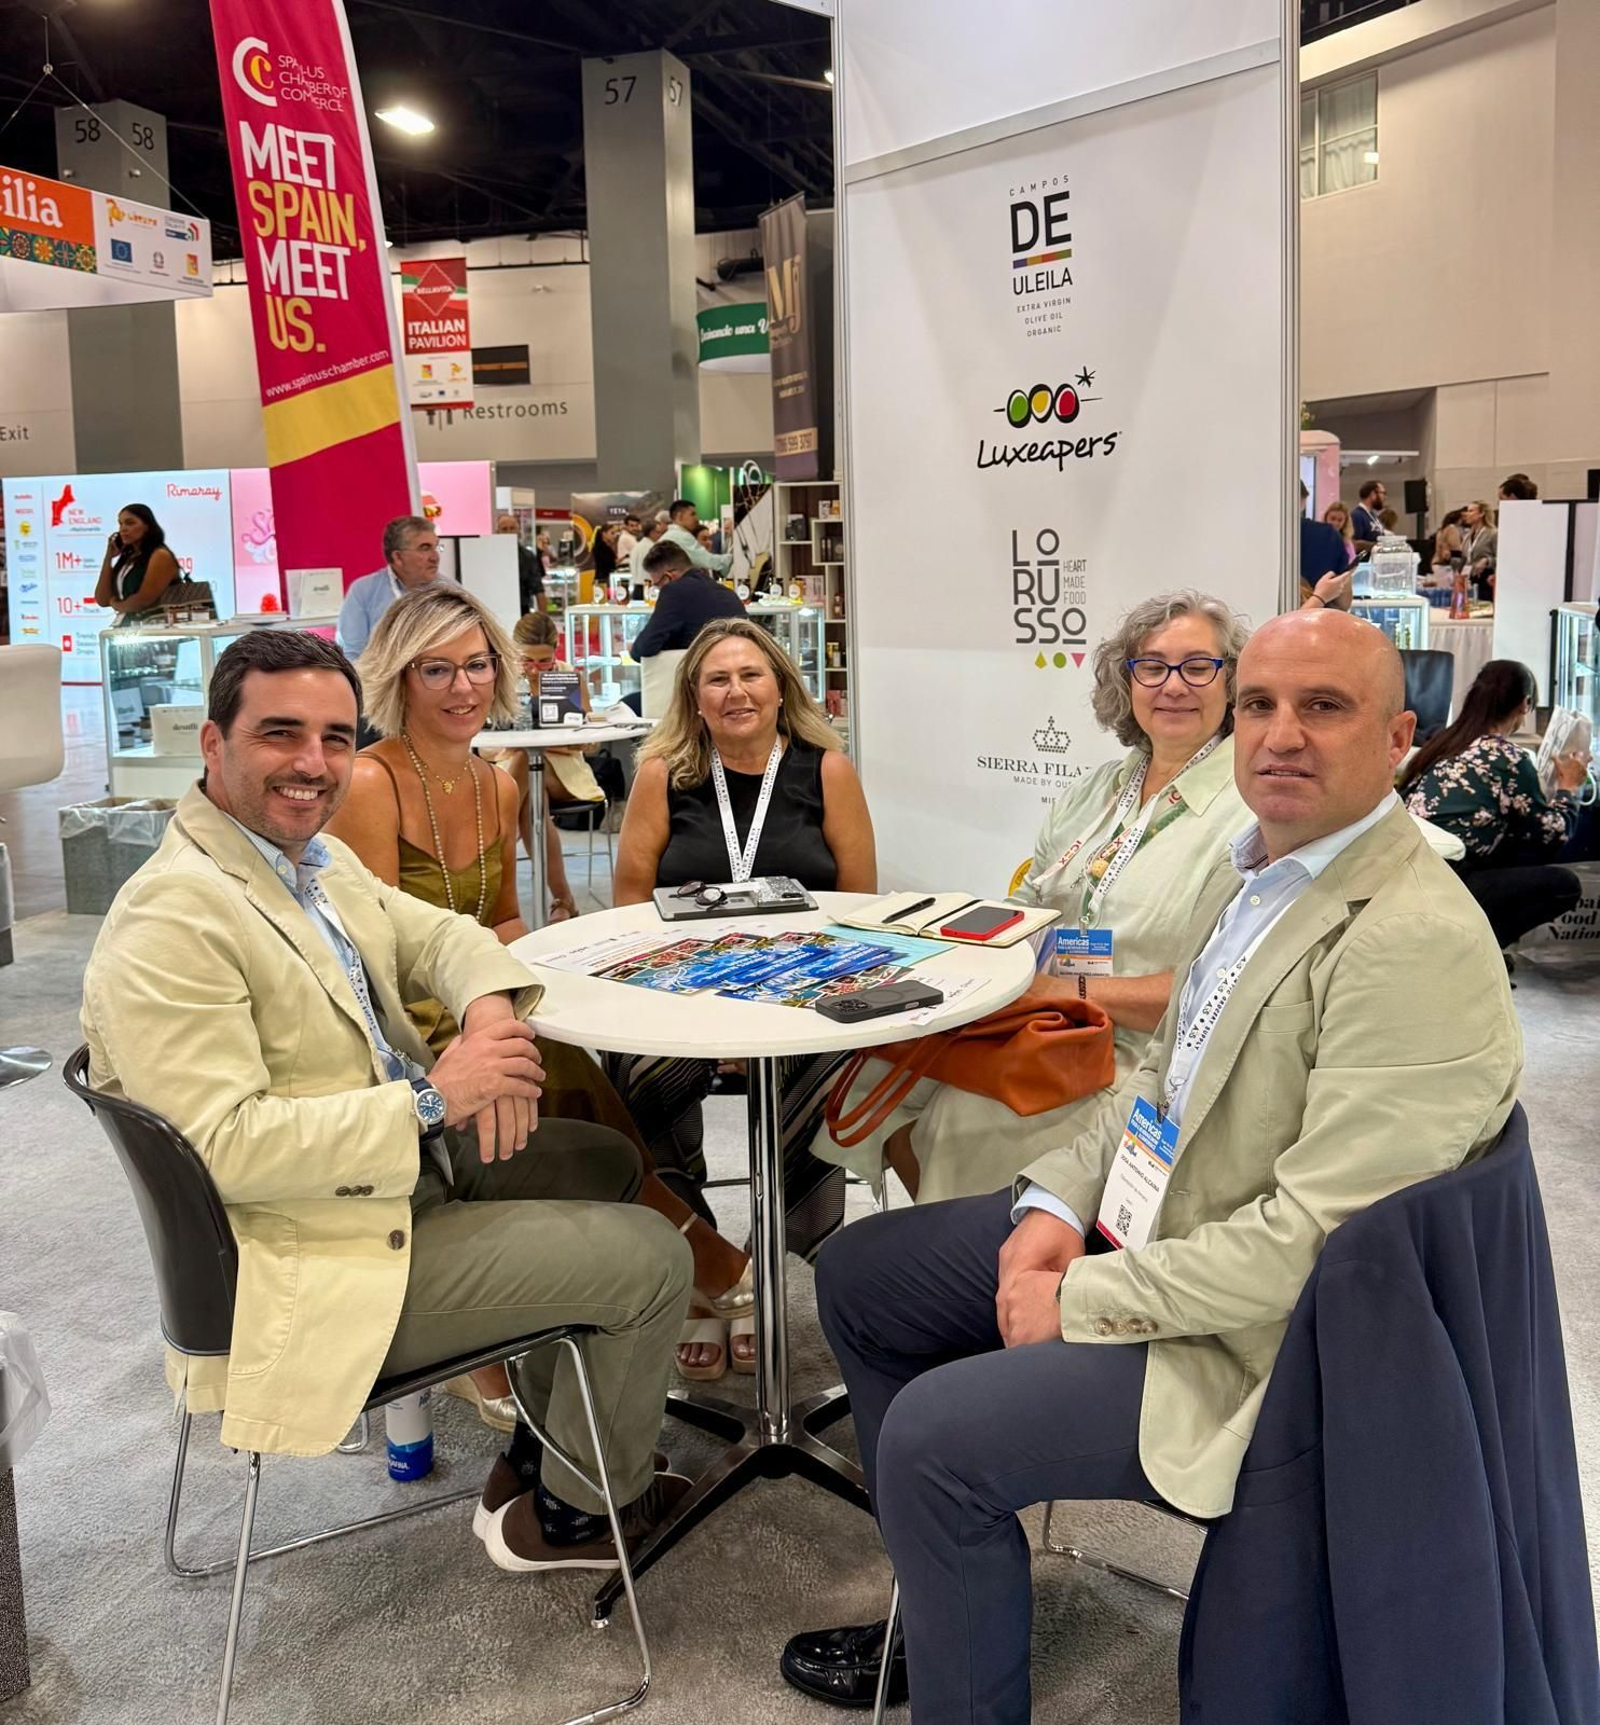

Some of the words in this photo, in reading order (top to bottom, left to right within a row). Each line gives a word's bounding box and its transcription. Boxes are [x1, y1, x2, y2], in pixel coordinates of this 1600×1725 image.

[604, 75, 637, 105] 57
[669, 75, 684, 107] 57
[75, 119, 101, 143] 58
[131, 122, 155, 151] 58
[238, 119, 337, 190] MEET
[1009, 174, 1069, 197] CAMPOS
[0, 174, 64, 228] ilia
[247, 180, 367, 254] SPAIN,
[1010, 190, 1072, 254] DE
[256, 236, 351, 300] MEET
[1012, 267, 1073, 296] ULEILA
[1016, 301, 1041, 313] EXTRA
[1043, 297, 1072, 309] VIRGIN
[265, 296, 326, 353] US.
[407, 318, 466, 336] ITALIAN
[1024, 314, 1047, 325] OLIVE
[1049, 312, 1063, 322] OIL
[408, 334, 467, 349] PAVILION
[1026, 325, 1062, 337] ORGANIC
[265, 347, 390, 397] www.spainuschamber.com
[463, 401, 568, 420] Restrooms
[0, 425, 30, 441] Exit
[977, 431, 1119, 472] Luxeapers
[1063, 559, 1087, 573] HEART
[1063, 576, 1086, 588] MADE
[1063, 591, 1087, 605] FOOD
[977, 755, 1039, 774] SIERRA
[1044, 761, 1091, 778] FILA
[1013, 775, 1038, 785] MADE
[1040, 778, 1052, 787] BY
[1561, 910, 1598, 925] ood
[1057, 936, 1090, 946] Americas
[1131, 1107, 1162, 1140] Americas
